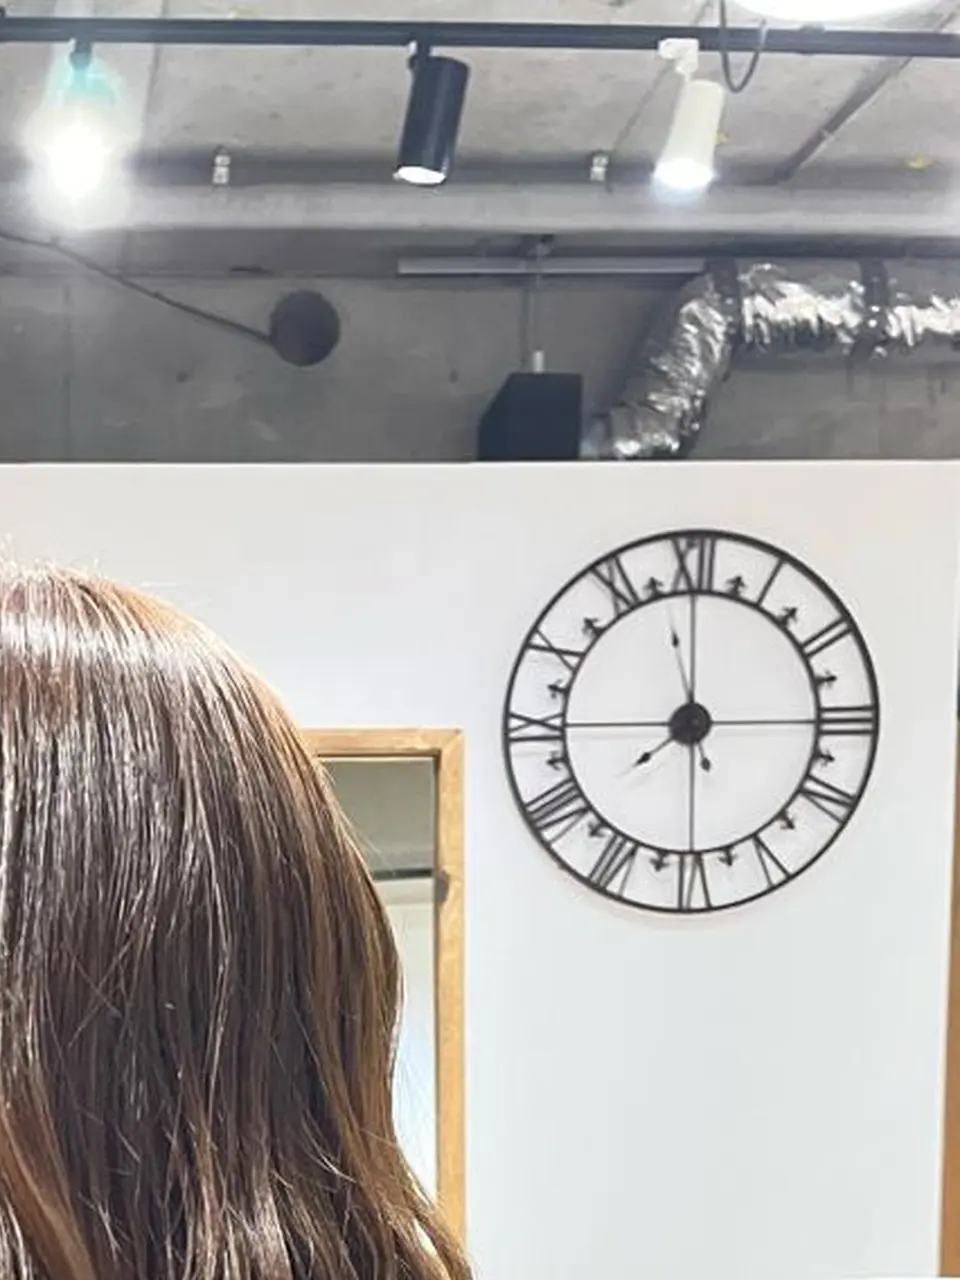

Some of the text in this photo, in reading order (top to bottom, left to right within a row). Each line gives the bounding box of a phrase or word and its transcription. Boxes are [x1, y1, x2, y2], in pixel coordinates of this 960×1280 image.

[591, 554, 641, 615] XI
[671, 536, 716, 592] XII
[507, 712, 565, 742] IX
[820, 705, 875, 736] III
[801, 775, 857, 823] IV
[678, 853, 712, 909] VI
